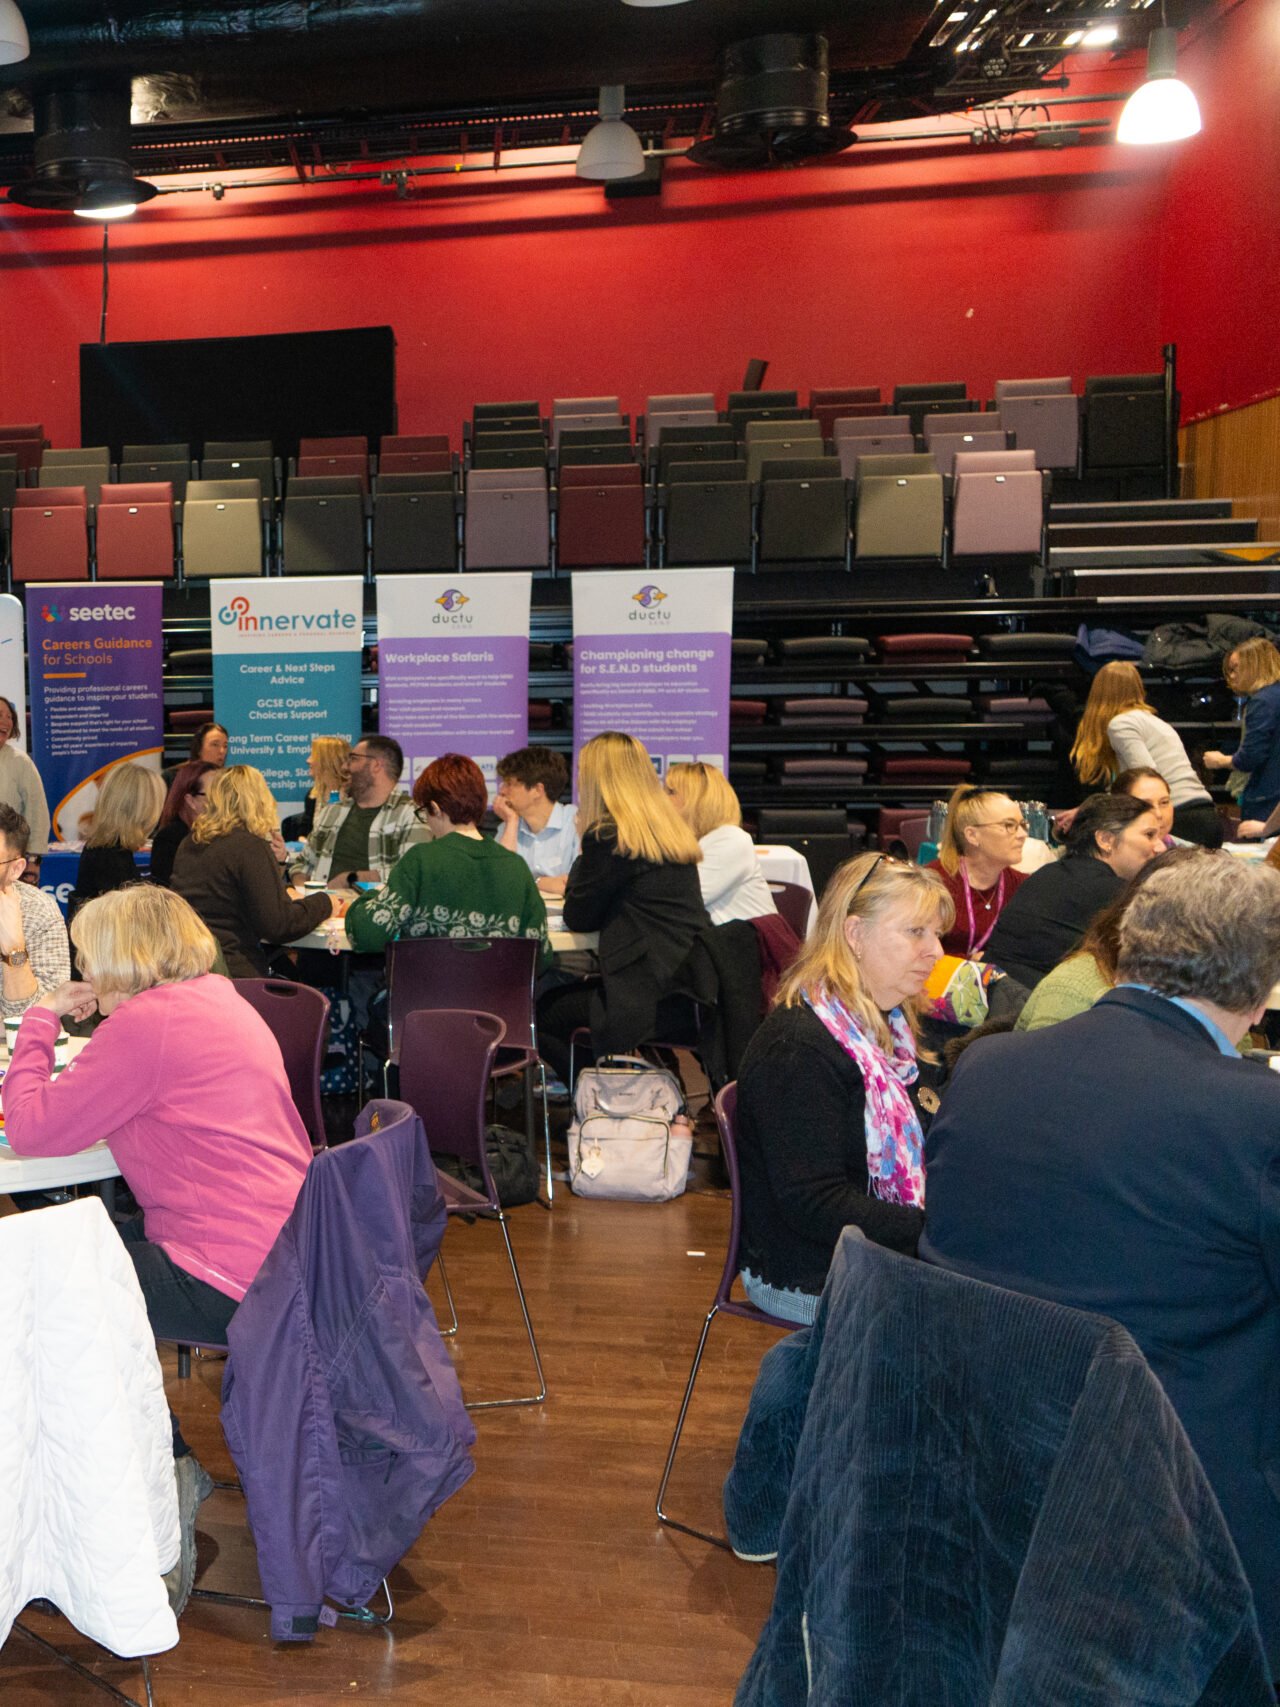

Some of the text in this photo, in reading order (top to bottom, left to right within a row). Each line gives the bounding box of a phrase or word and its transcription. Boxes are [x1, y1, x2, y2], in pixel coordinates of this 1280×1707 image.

[69, 604, 137, 621] seetec
[432, 613, 473, 624] ductu
[628, 610, 671, 620] ductu
[238, 609, 356, 631] innervate
[42, 637, 153, 650] Careers Guidance
[43, 652, 113, 665] for Schools
[385, 651, 494, 665] Workplace Safaris
[580, 648, 714, 662] Championing change
[240, 662, 335, 674] Career & Next Steps
[580, 662, 698, 674] for S.E.N.D students
[270, 675, 305, 685] Advice
[44, 686, 77, 695] Providing
[78, 684, 120, 693] professional
[44, 695, 75, 704] guidance
[77, 694, 85, 702] to
[86, 694, 110, 702] inspire
[111, 694, 127, 702] your
[257, 698, 319, 709] GCSE Option
[249, 709, 327, 720] Choices Support
[228, 735, 248, 745] ong
[250, 733, 273, 742] Term
[275, 733, 308, 743] Career
[230, 745, 275, 756] University
[277, 745, 284, 754] &
